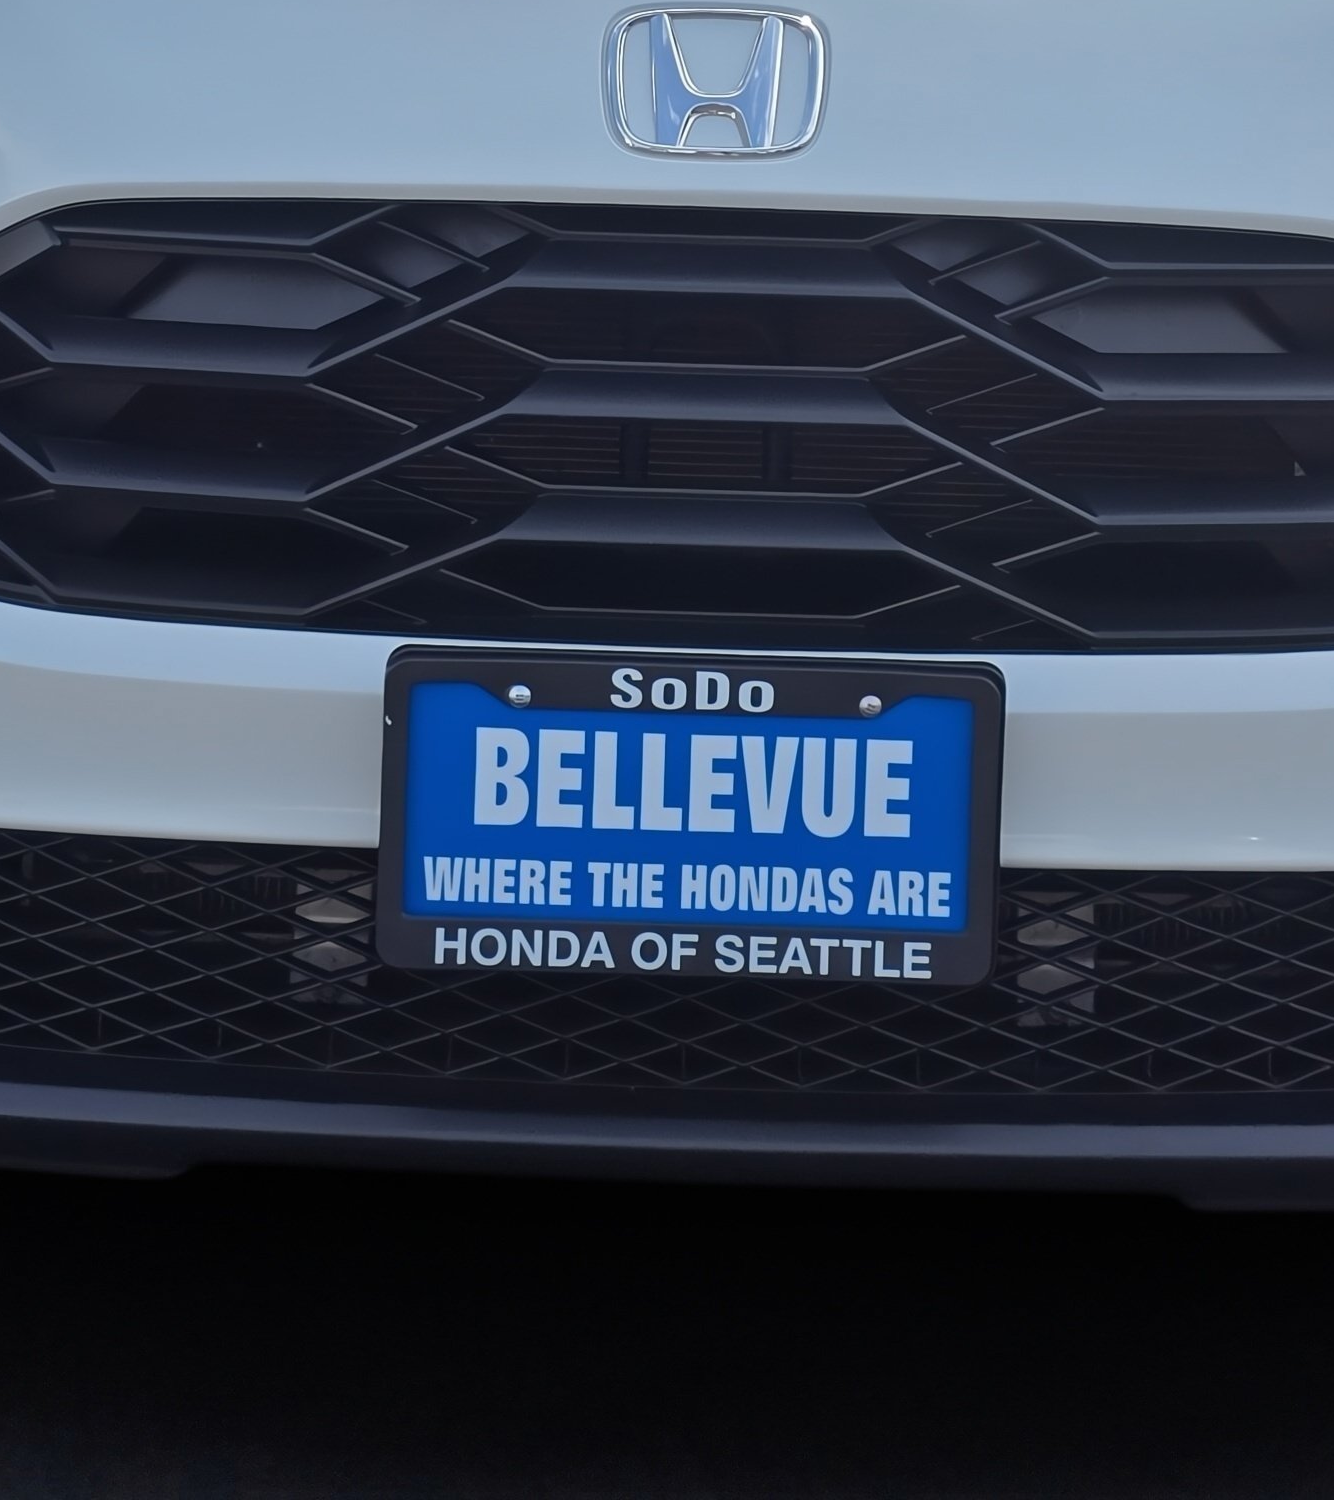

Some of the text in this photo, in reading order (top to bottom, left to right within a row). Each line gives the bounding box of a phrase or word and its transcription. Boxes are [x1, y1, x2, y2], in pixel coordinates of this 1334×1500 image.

[610, 667, 775, 712] SoDo
[473, 726, 914, 838] BELLEVUE
[423, 856, 951, 917] WHERE THE HONDAS ARE
[434, 927, 932, 980] HONDA OF SEATTLE
